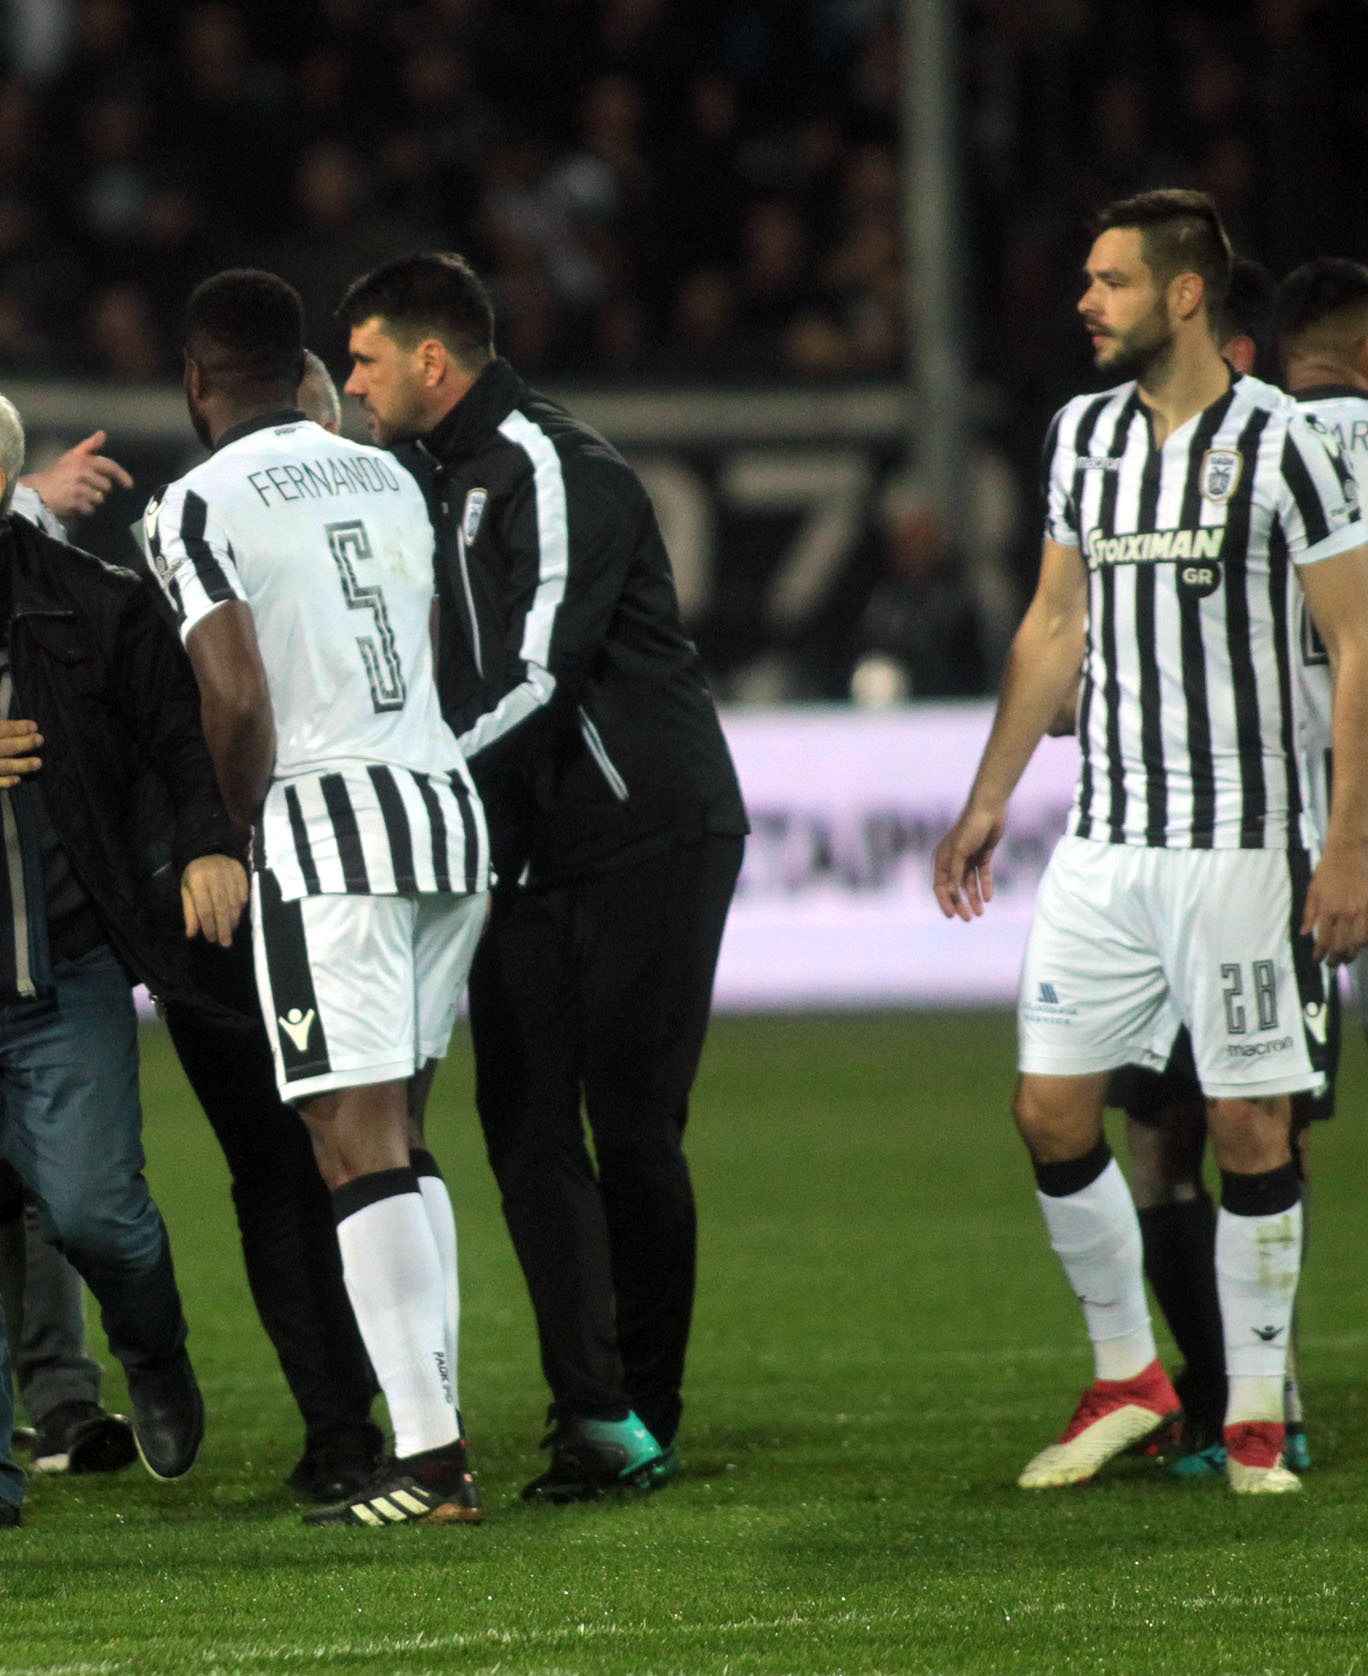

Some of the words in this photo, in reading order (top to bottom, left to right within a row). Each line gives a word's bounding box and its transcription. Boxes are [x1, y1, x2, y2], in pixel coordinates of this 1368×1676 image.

[247, 455, 400, 507] FERNANDO
[1088, 526, 1226, 570] STOIXIMAN
[1183, 567, 1214, 585] GR
[324, 519, 407, 714] 5
[1221, 960, 1278, 1034] 28
[1225, 1036, 1293, 1056] macron
